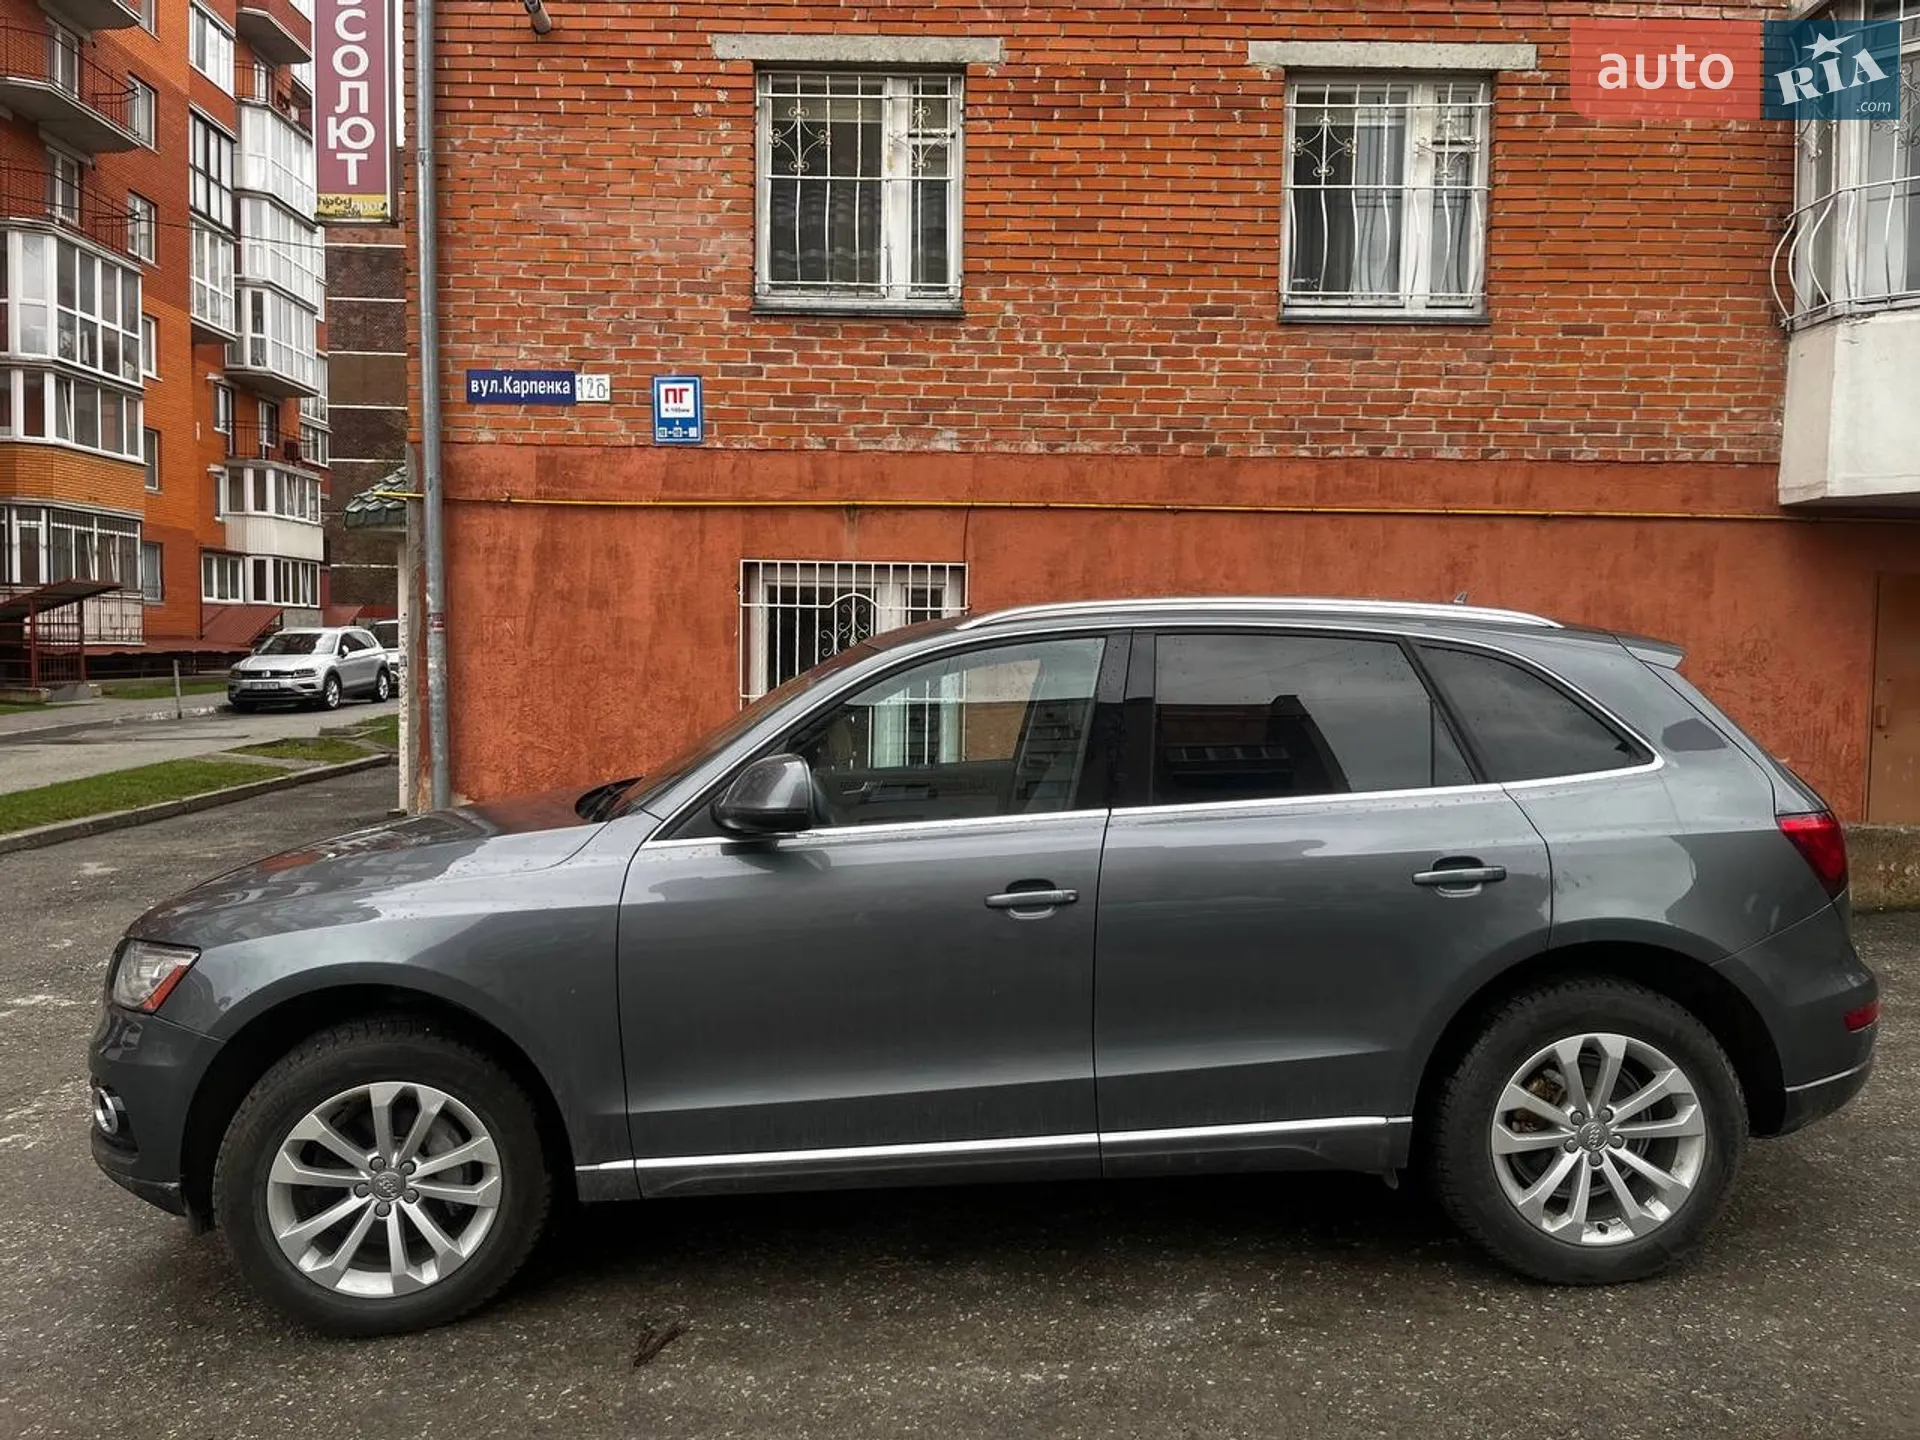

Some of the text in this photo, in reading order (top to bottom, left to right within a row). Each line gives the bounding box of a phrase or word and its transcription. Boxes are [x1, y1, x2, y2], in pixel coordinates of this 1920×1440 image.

[327, 0, 376, 186] СОЛЮТ
[470, 376, 571, 398] вул.Карпенка
[664, 387, 690, 404] ПГ
